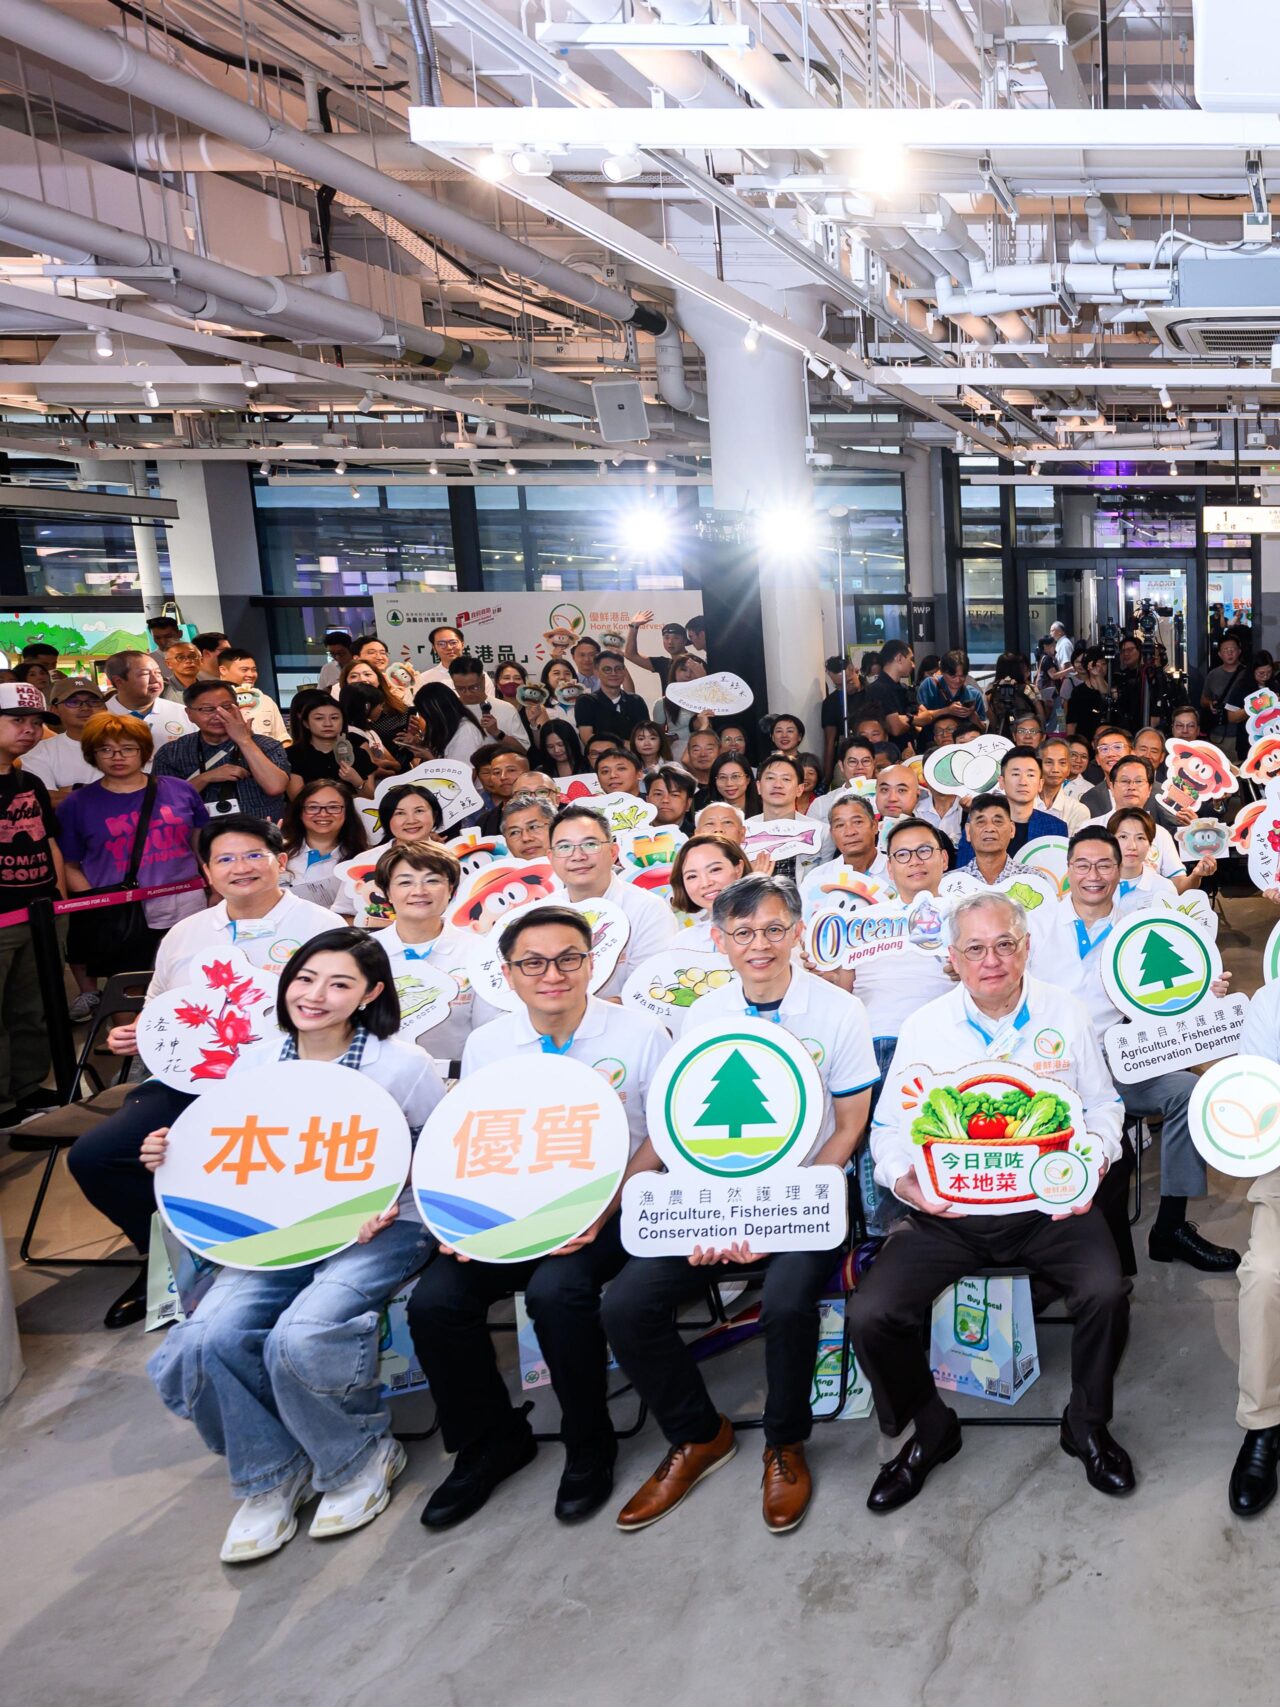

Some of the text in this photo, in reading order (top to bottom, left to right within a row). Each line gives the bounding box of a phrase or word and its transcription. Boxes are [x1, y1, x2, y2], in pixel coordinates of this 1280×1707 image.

[589, 611, 630, 622] 優鮮港品
[913, 606, 931, 614] RWP
[590, 623, 609, 632] Hong
[611, 622, 632, 631] Kon
[423, 767, 463, 775] Pompano
[105, 805, 184, 836] KIL
[105, 826, 190, 860] YUR
[1, 866, 48, 881] SOUP
[811, 912, 908, 966] Ocean
[848, 940, 903, 964] Hong Kong
[1117, 1004, 1244, 1049] 漁農自然護理署
[1121, 1037, 1181, 1060] Agriculture,
[1182, 1023, 1227, 1043] Fisheries
[1124, 1032, 1241, 1072] Conservation Departme
[202, 1115, 379, 1185] 本地
[452, 1103, 601, 1179] 優質
[941, 1152, 1025, 1170] 今日買咗
[949, 1173, 1017, 1193] 本地菜
[639, 1184, 829, 1206] 漁農自然護理署
[638, 1202, 830, 1225] Agriculture, Fisheries and
[638, 1220, 831, 1241] Conservation Department
